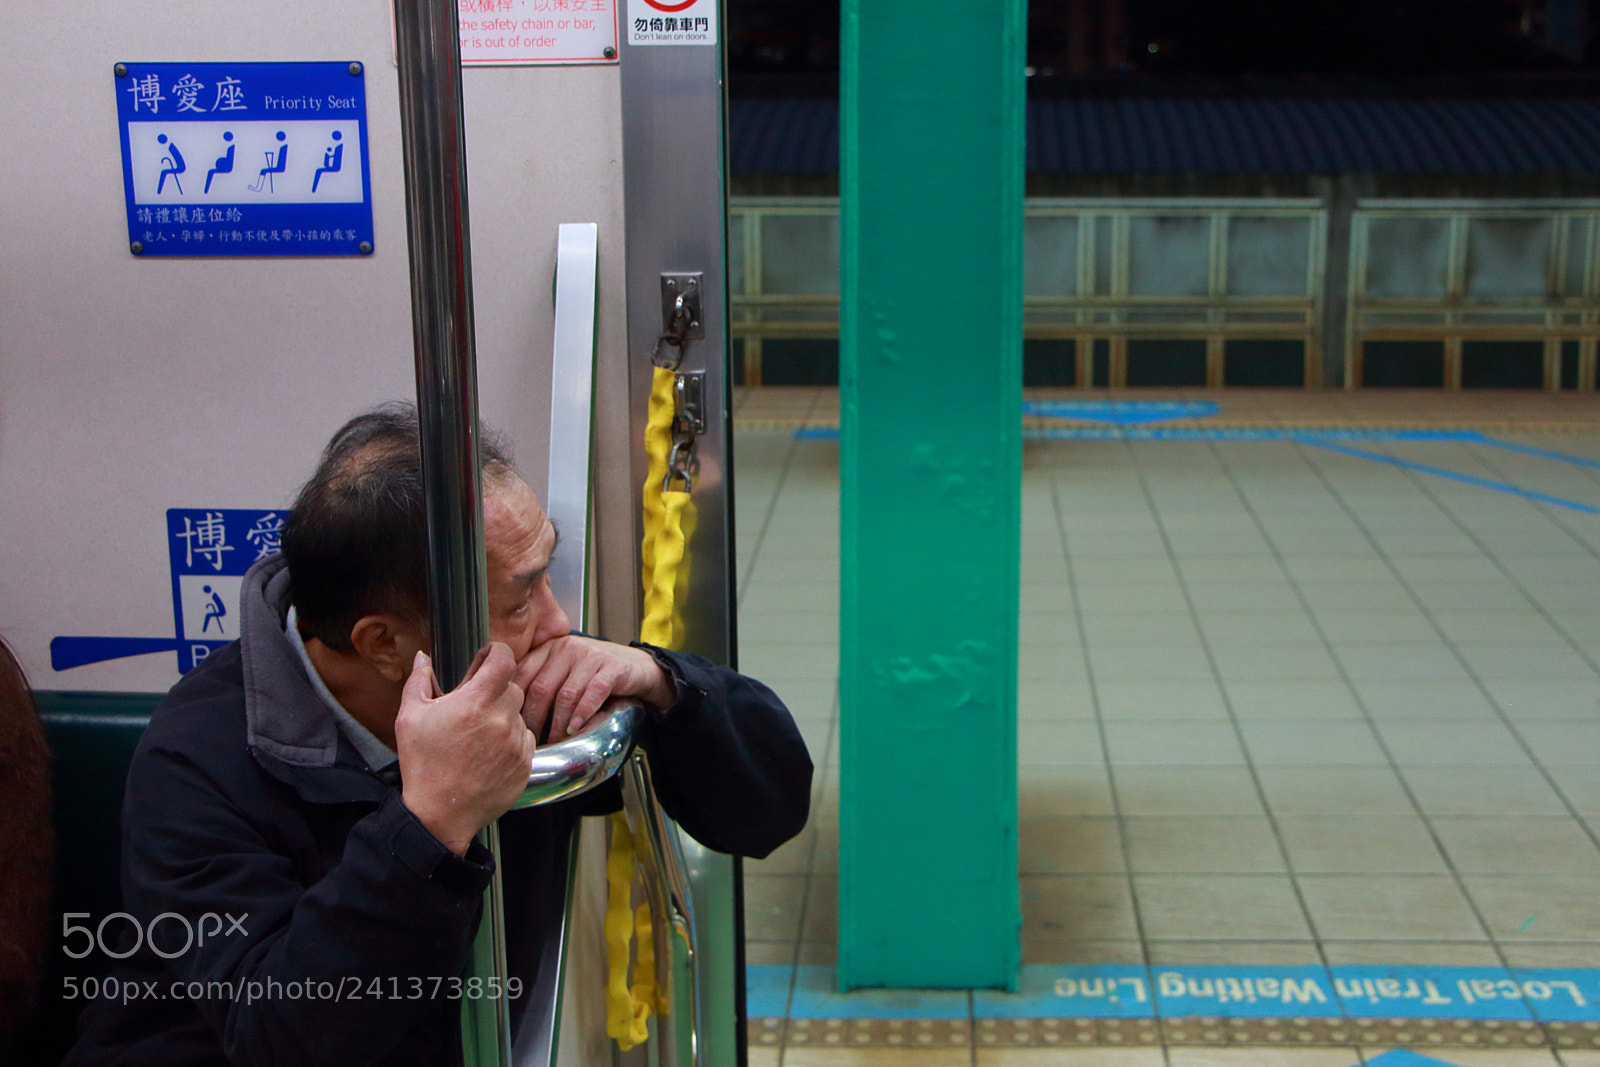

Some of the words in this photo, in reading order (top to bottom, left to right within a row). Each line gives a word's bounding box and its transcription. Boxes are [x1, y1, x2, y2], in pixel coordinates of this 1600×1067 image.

[481, 18, 518, 33] safety
[521, 18, 554, 30] chain
[557, 20, 570, 30] or
[574, 17, 596, 31] bar,
[634, 17, 708, 32] 勿倚靠車門
[472, 37, 482, 48] is
[485, 37, 505, 48] out
[508, 36, 520, 48] of
[523, 35, 556, 48] order
[127, 73, 248, 114] 博愛座
[264, 95, 322, 111] Priority
[328, 95, 357, 109] Seat
[136, 207, 243, 224] 請禮讓座位給
[1053, 977, 1147, 1003] Line
[1157, 971, 1327, 1005] Waiting
[1334, 977, 1452, 1005] Train
[1456, 979, 1587, 1007] Local
